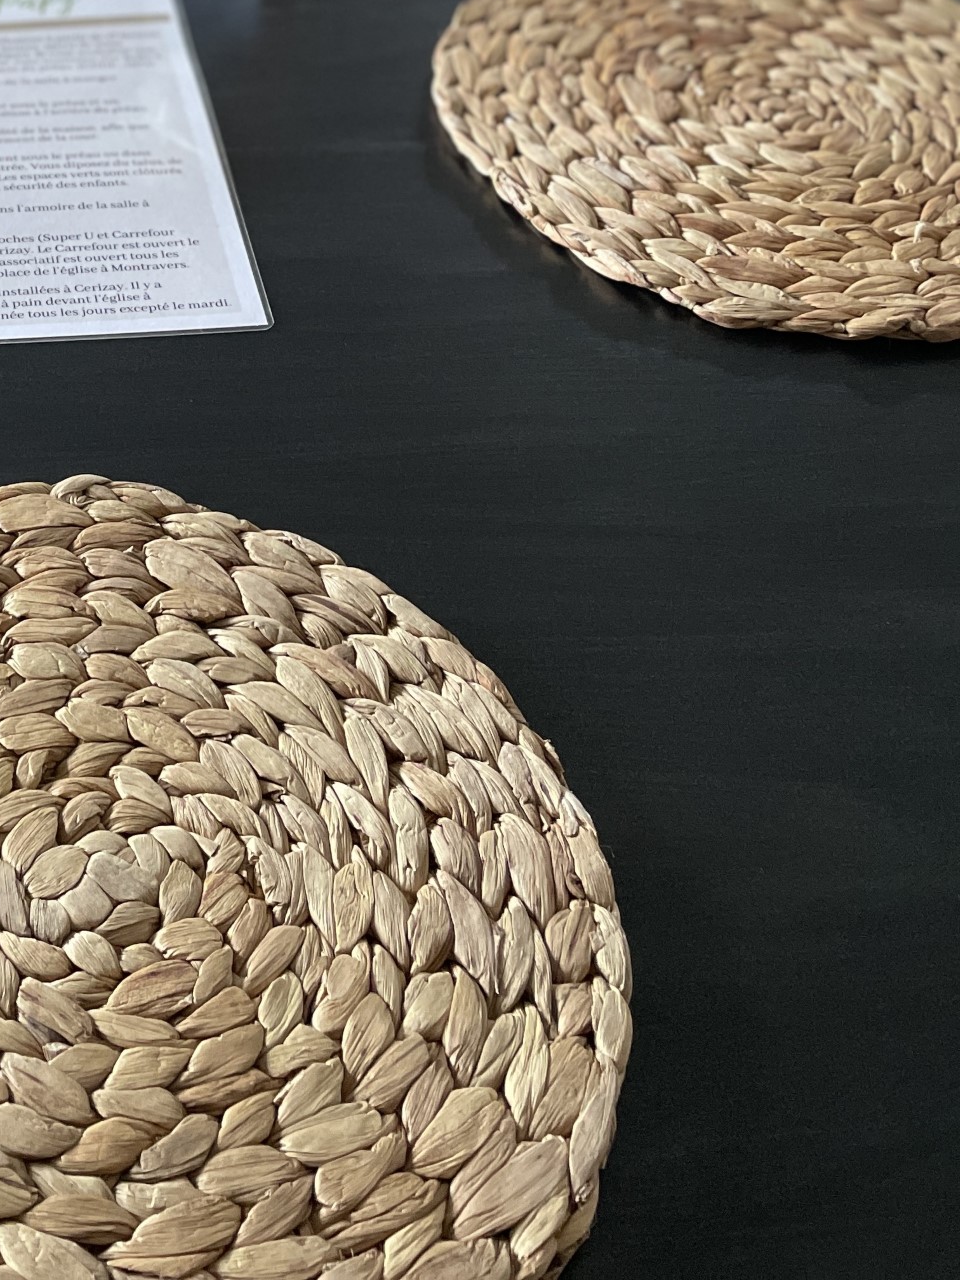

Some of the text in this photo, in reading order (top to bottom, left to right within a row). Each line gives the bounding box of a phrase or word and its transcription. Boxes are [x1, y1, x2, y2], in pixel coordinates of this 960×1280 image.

[20, 154, 48, 162] sous
[50, 152, 62, 160] le
[19, 174, 67, 183] espaces
[102, 170, 129, 178] sont
[132, 167, 182, 177] clôturés
[3, 181, 53, 192] sécurité
[55, 181, 77, 189] des
[79, 179, 128, 188] enfants.
[17, 203, 74, 214] l'armoire
[77, 202, 92, 211] de
[96, 201, 107, 210] la
[110, 199, 138, 209] salle
[142, 199, 149, 208] à
[37, 234, 81, 244] (Super
[84, 232, 93, 241] U
[96, 232, 108, 240] et
[111, 229, 174, 239] Carrefour
[37, 245, 51, 254] Le
[54, 242, 118, 253] Carrefour
[121, 241, 139, 250] est
[142, 239, 184, 249] ouvert
[188, 237, 199, 247] le
[62, 255, 81, 264] est
[84, 253, 127, 263] ouvert
[129, 252, 158, 260] tous
[161, 250, 179, 259] les
[33, 267, 49, 276] de
[52, 265, 97, 277] l'église
[100, 264, 108, 273] à
[111, 263, 190, 272] Montravers.
[63, 284, 71, 293] à
[74, 283, 128, 293] Cerizay.
[130, 281, 139, 290] Il
[143, 283, 149, 292] y
[0, 299, 8, 308] à
[12, 297, 42, 309] pain
[45, 295, 91, 305] devant
[94, 292, 139, 304] l'église
[143, 291, 150, 300] à
[27, 310, 56, 318] tous
[60, 307, 78, 316] les
[82, 306, 116, 317] jours
[119, 301, 169, 313] excepté
[172, 301, 184, 310] le
[188, 298, 232, 309] mardi.
